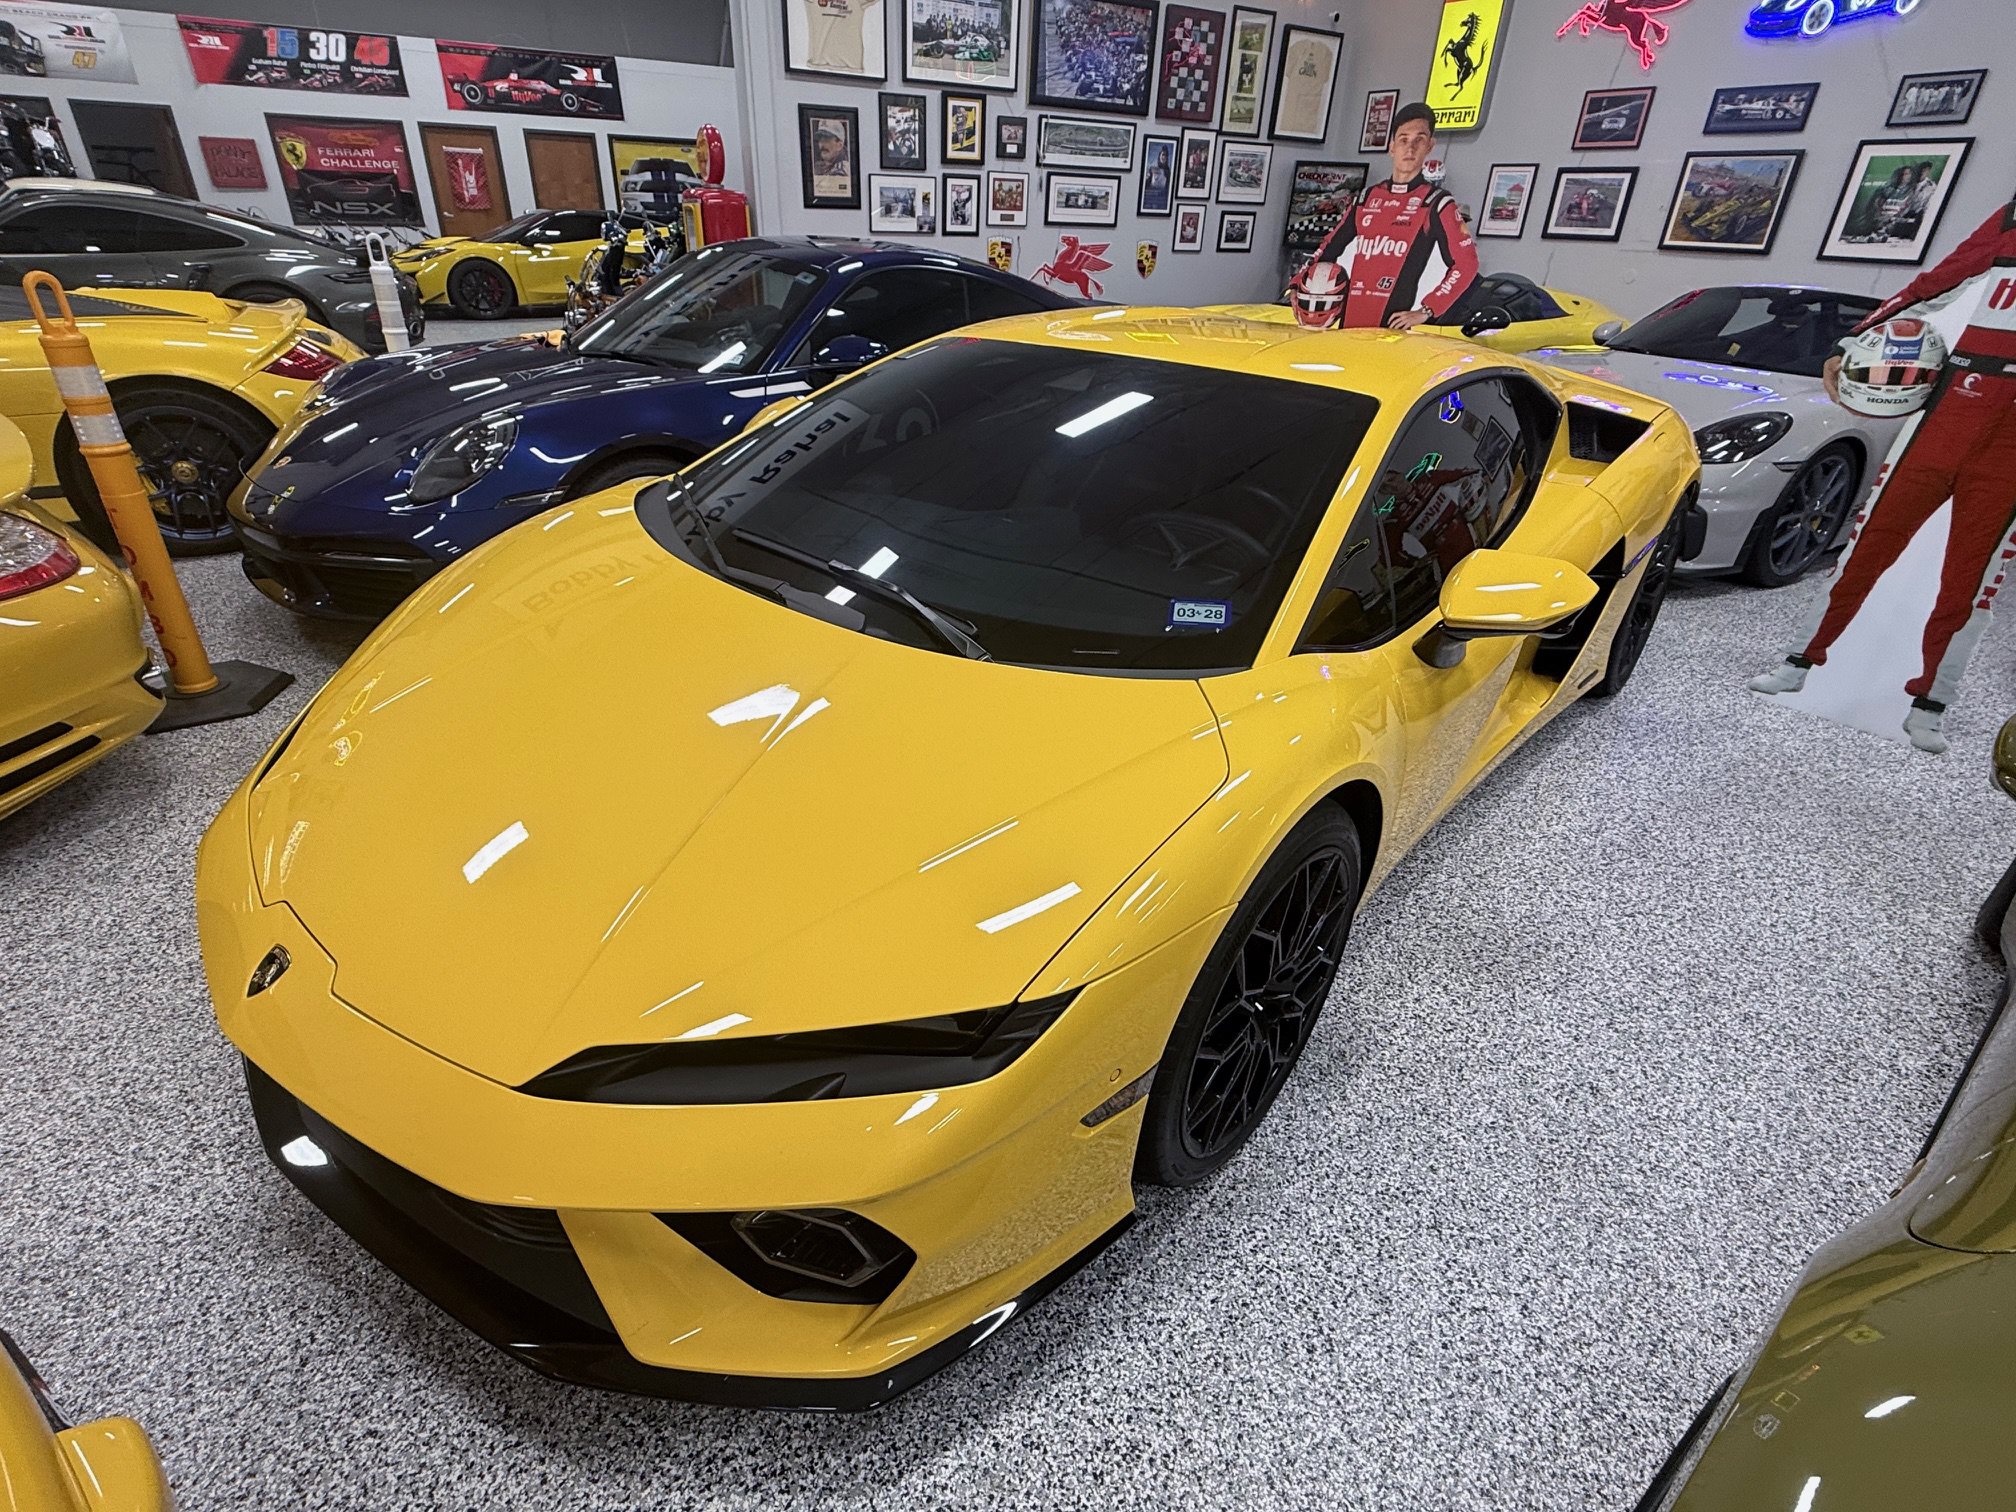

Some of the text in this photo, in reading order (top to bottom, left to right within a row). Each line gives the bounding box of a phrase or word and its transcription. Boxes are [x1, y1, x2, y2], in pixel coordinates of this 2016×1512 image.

[263, 26, 299, 59] 15
[308, 31, 347, 62] 30
[1434, 109, 1477, 124] errari
[317, 146, 375, 158] FERRARI
[320, 158, 399, 169] CHALLENGE
[312, 200, 396, 216] NSX
[1377, 277, 1393, 289] 45
[1866, 396, 1909, 405] HONDA
[1203, 609, 1223, 619] 28
